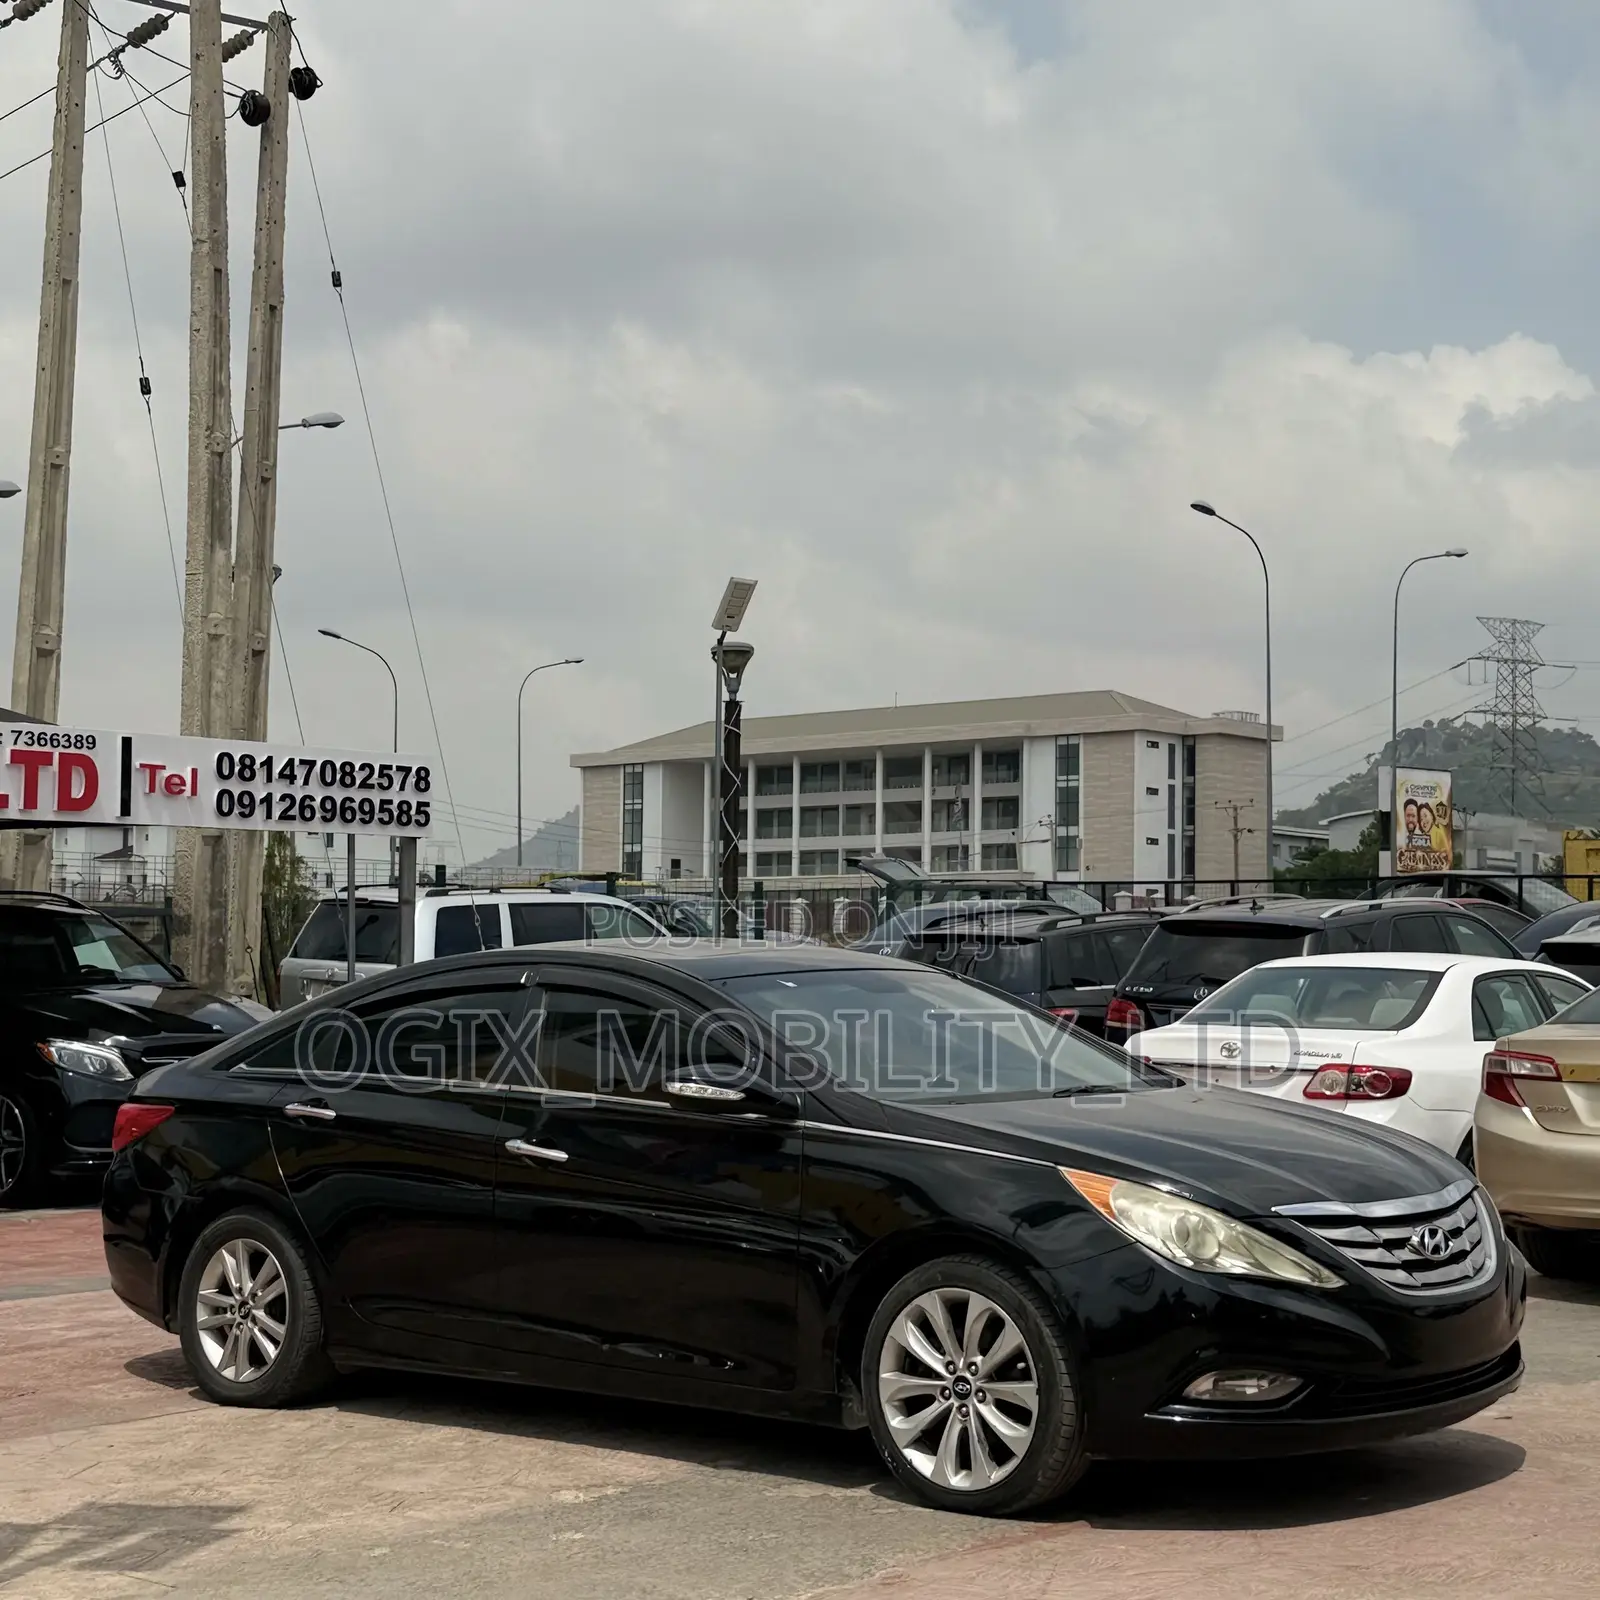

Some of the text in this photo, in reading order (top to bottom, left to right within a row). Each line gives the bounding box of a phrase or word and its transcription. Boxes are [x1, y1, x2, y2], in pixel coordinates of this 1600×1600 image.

[10, 730, 97, 750] 7366389
[0, 749, 99, 812] TD
[139, 763, 198, 797] Tel
[215, 752, 431, 794] 08147082578
[215, 788, 431, 828] 09126969585
